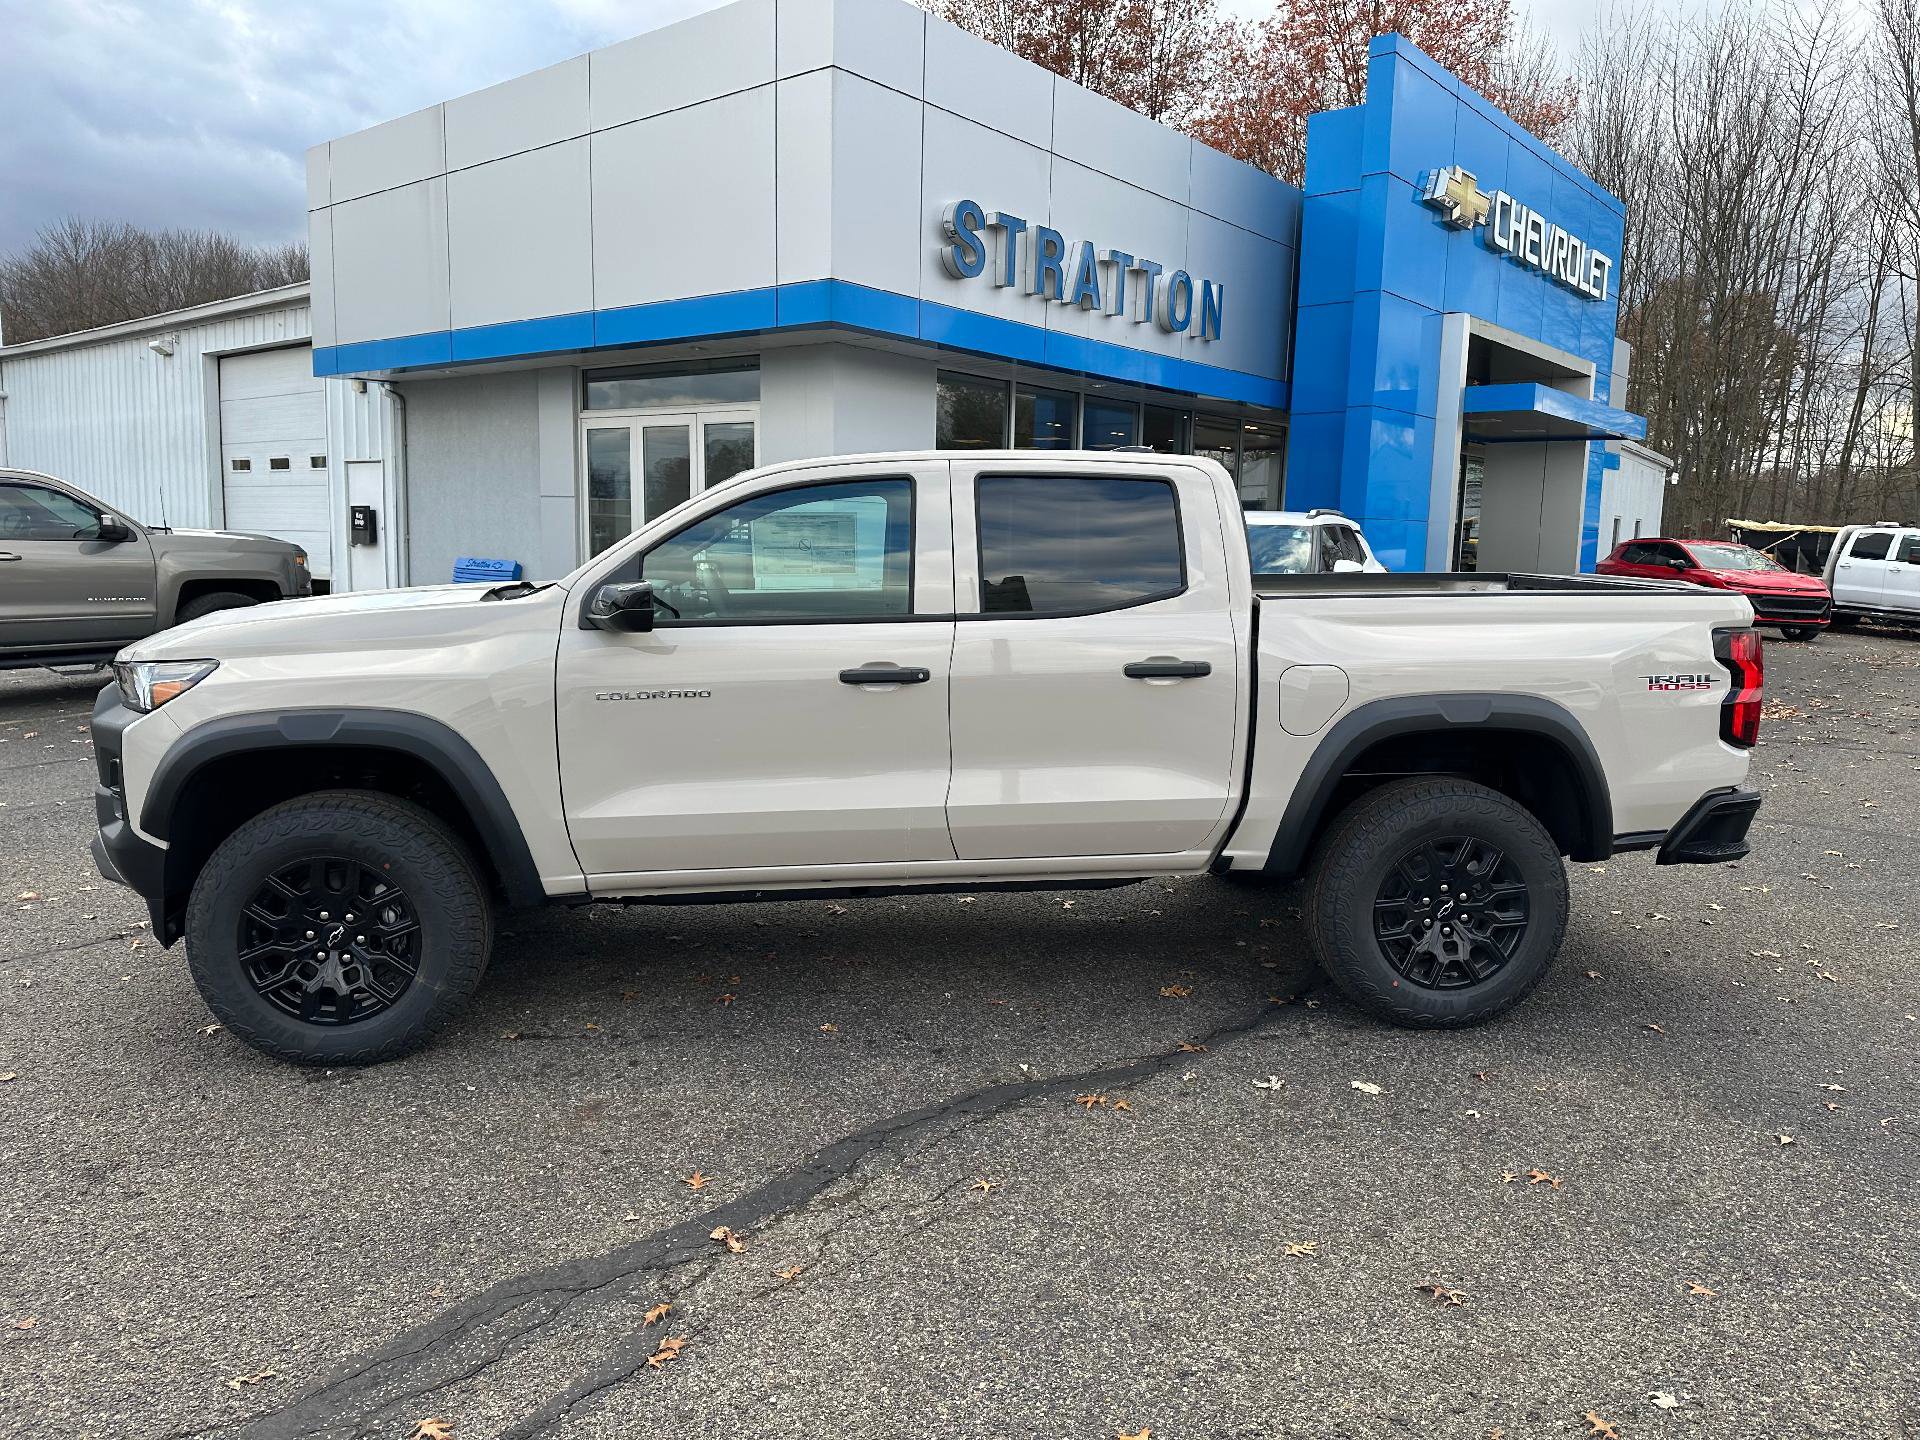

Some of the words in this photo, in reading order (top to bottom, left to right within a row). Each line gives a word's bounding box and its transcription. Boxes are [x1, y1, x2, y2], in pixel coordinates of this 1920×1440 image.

[1486, 189, 1613, 302] CHEVROLET
[941, 199, 1224, 341] STRATTON
[1638, 673, 1720, 684] TRAIL
[1647, 683, 1711, 691] BOSS
[595, 689, 711, 701] COLORADO
